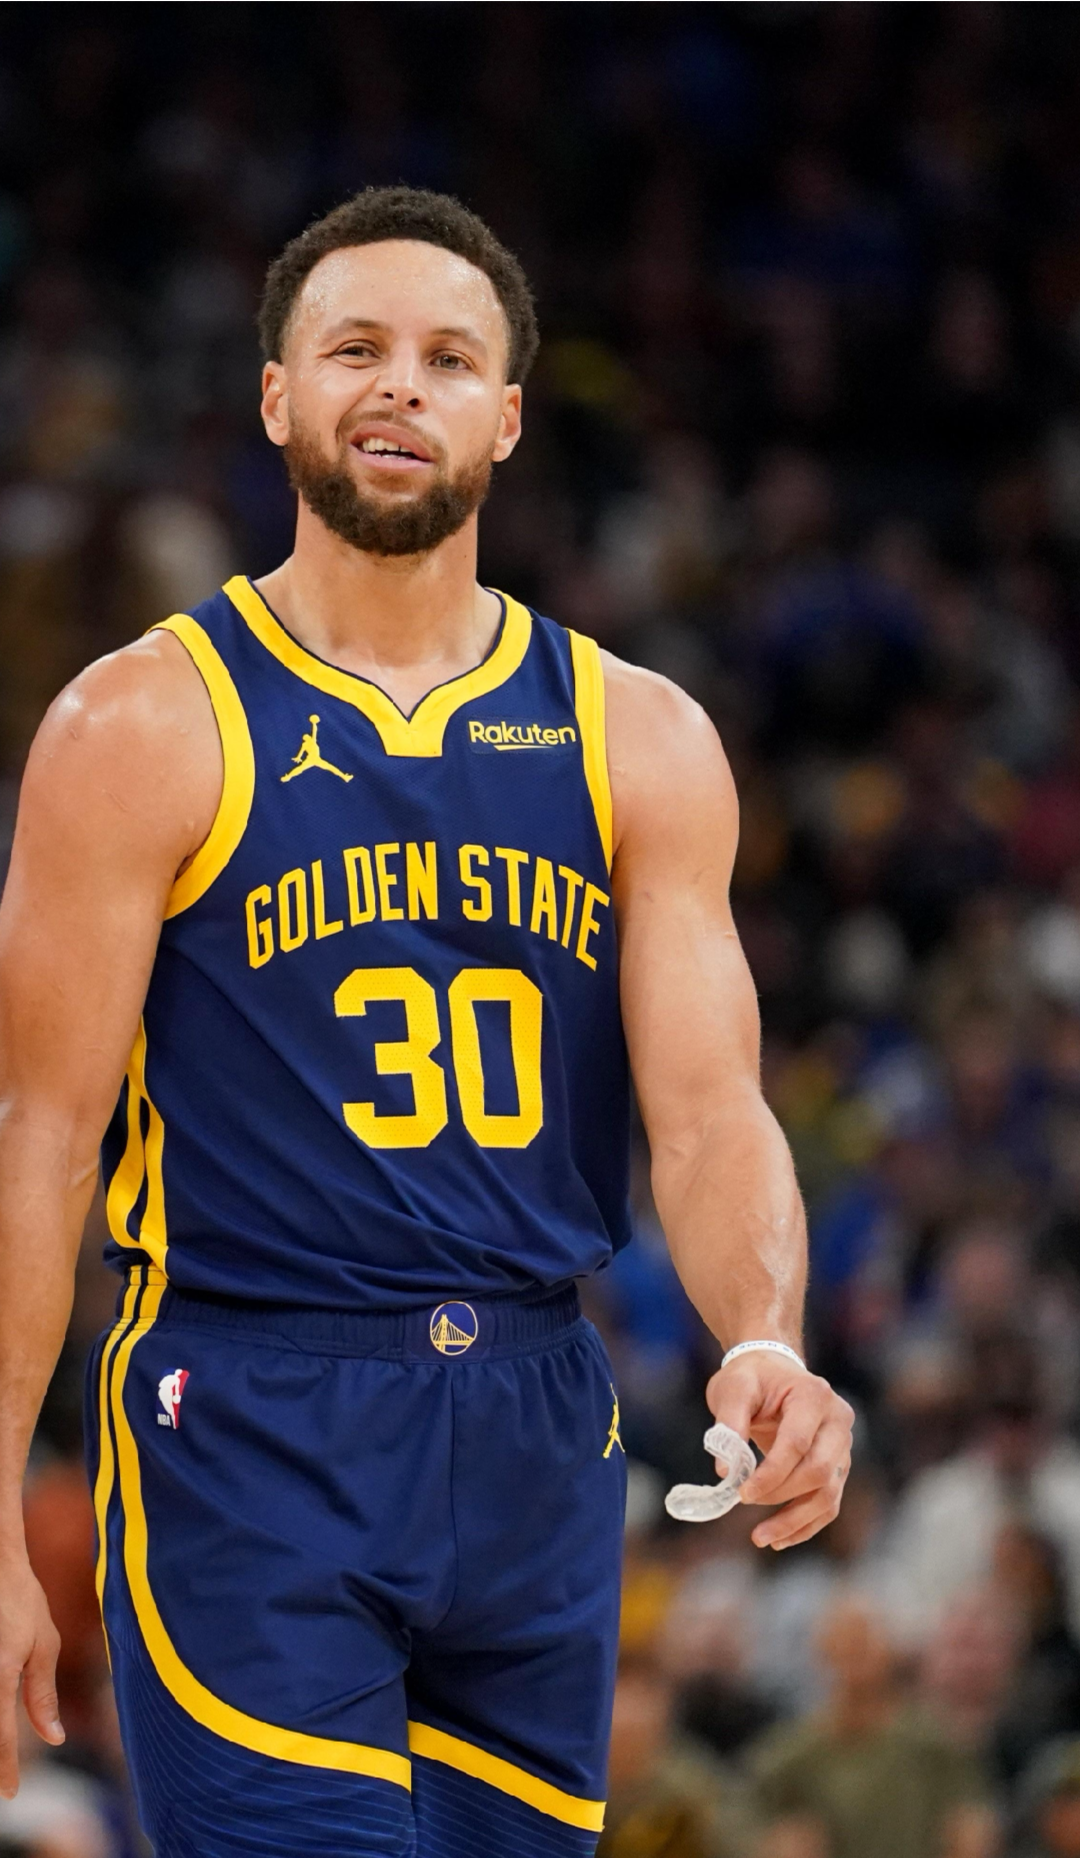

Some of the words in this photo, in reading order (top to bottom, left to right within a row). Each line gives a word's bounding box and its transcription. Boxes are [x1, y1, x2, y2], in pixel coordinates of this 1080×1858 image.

[468, 721, 576, 746] Rakuten
[245, 840, 438, 971] GOLDEN
[459, 844, 610, 970] STATE
[333, 967, 543, 1149] 30
[157, 1413, 171, 1426] NBA
